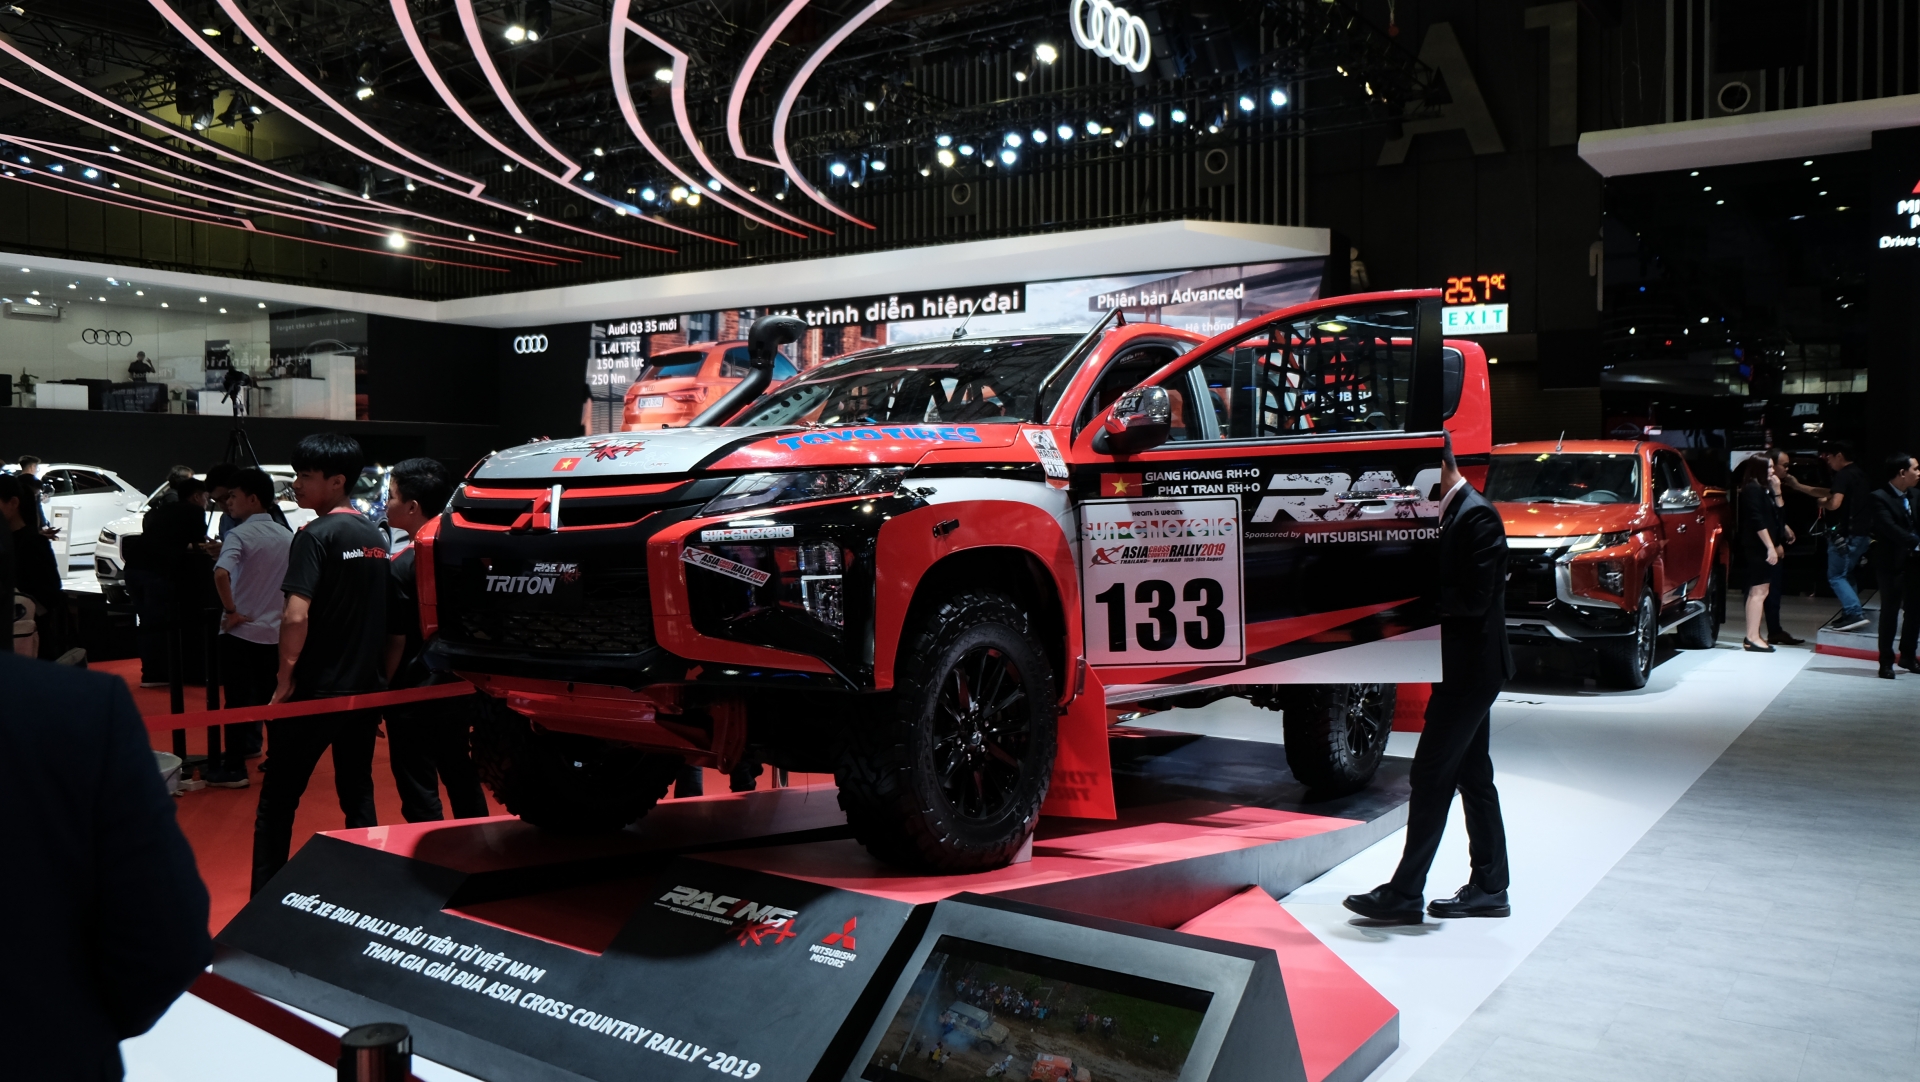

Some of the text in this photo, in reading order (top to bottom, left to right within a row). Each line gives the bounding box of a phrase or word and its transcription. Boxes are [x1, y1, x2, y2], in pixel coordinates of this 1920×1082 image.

[1880, 236, 1916, 248] Drive
[1097, 283, 1244, 308] Phiên bản Advanced
[806, 306, 859, 326] trình
[865, 296, 915, 322] diễn
[922, 294, 974, 318] hiện
[981, 290, 1019, 314] đại
[1449, 309, 1503, 326] EXIT
[608, 319, 677, 336] Audi Q3 35 mới
[621, 341, 640, 353] TFSI
[597, 357, 644, 370] 150 mã lực
[592, 374, 625, 385] 250 Nm
[776, 427, 982, 451] TOYO TIRES
[1145, 468, 1260, 482] GIANG HOANG RH+O
[1158, 482, 1261, 496] PHAT TRAN RH+O
[1245, 531, 1301, 539] Sponsored by
[1304, 528, 1440, 544] MITSUBISHI MOTORS
[1121, 545, 1148, 560] ASIA
[1148, 545, 1170, 553] CROSS
[1169, 544, 1202, 557] RALLY
[1200, 542, 1226, 556] 2019
[701, 554, 720, 566] ASIA
[731, 565, 753, 577] RALLY
[750, 571, 768, 582] 2019
[486, 575, 556, 595] TRITON
[1095, 578, 1225, 653] 133
[659, 885, 799, 928] RACING
[282, 892, 320, 912] CHIẾC
[313, 902, 336, 917] XE
[329, 907, 360, 926] ĐUA
[355, 915, 400, 937] RALLY
[393, 925, 428, 946] ĐẦU
[422, 936, 458, 956] TIÊN
[473, 952, 512, 972] VIỆT
[504, 961, 546, 984] NAM
[809, 944, 856, 962] MITSUBISHI
[810, 953, 845, 968] MOTORS
[363, 941, 405, 965] THAM
[400, 954, 428, 972] GIA
[423, 961, 458, 982] GIẢI
[451, 971, 487, 992] ĐUA
[482, 981, 522, 1004] ASIA
[519, 993, 574, 1020] CROSS
[569, 1008, 652, 1044] COUNTRY
[644, 1032, 708, 1063] RALLY
